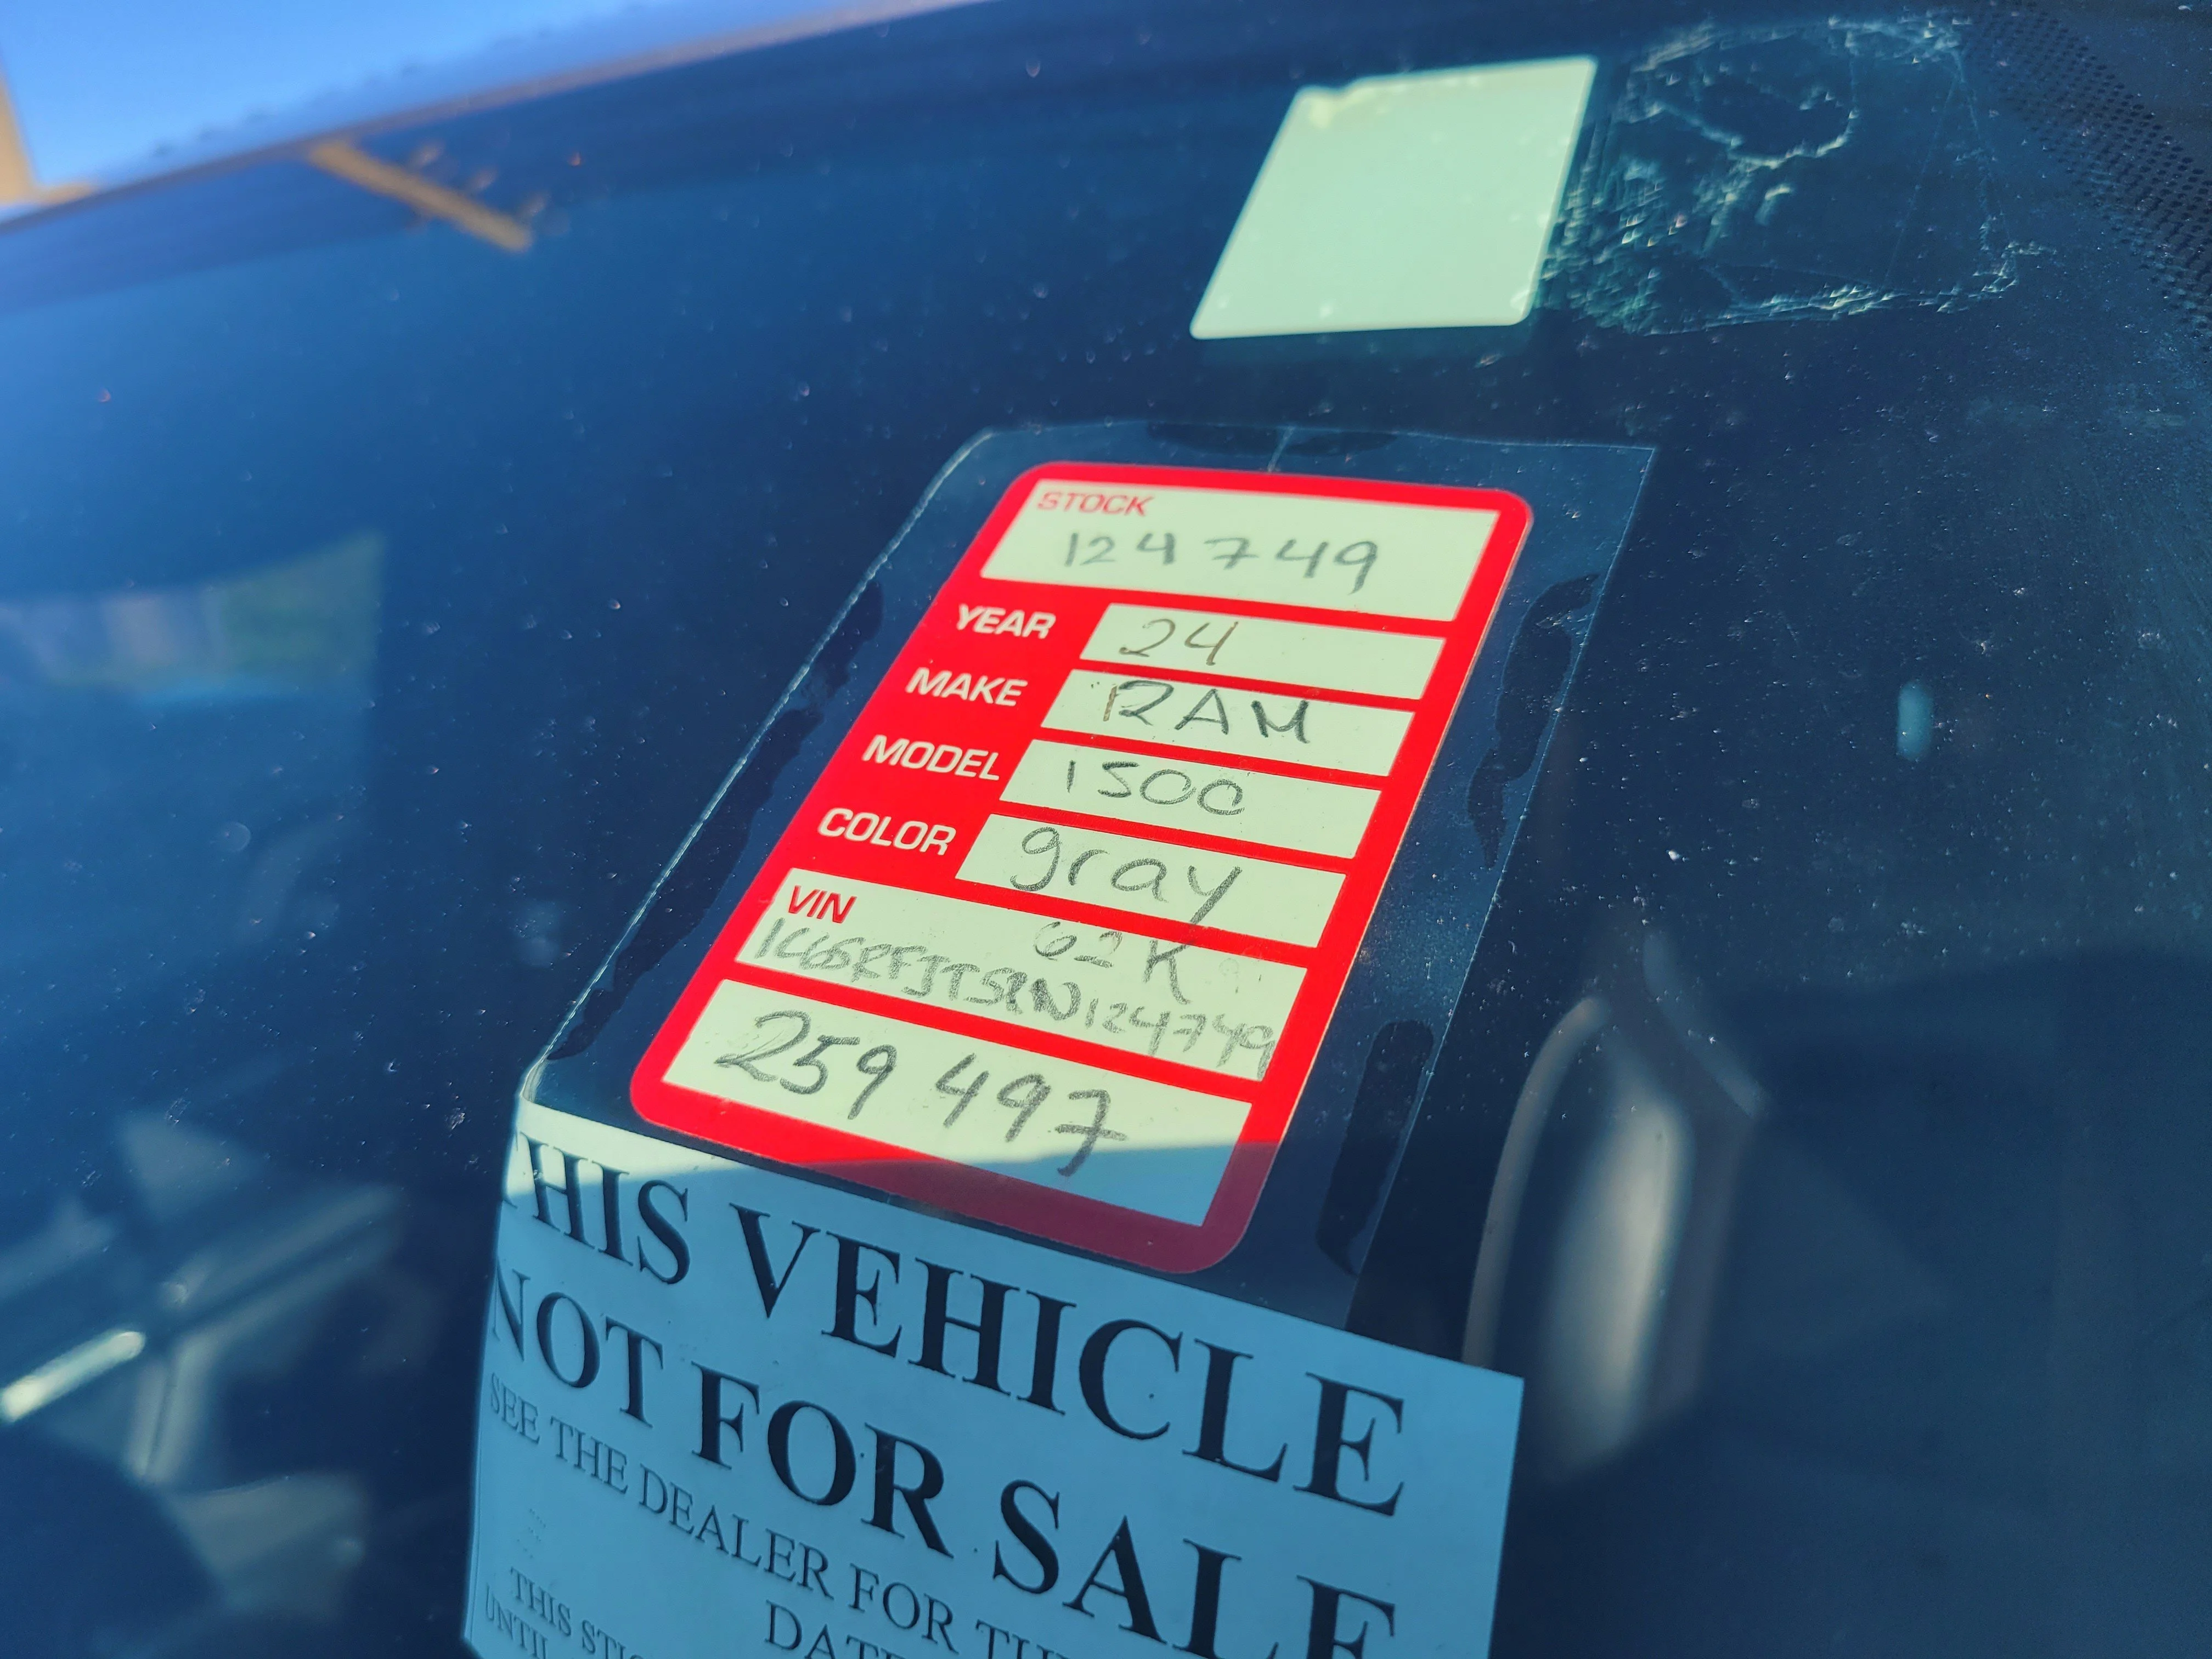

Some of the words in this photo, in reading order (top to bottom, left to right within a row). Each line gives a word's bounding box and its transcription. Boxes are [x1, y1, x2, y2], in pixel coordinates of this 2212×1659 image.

[1036, 490, 1154, 517] STOCK
[956, 604, 1057, 640] YEAR
[1118, 618, 1239, 666] 24
[905, 667, 1029, 708] MAKE
[1102, 678, 1310, 745] RAM
[863, 735, 1001, 782] MODEL
[1065, 759, 1245, 816] 1500
[818, 807, 957, 857] COLOR
[1010, 826, 1242, 924] gray
[786, 884, 857, 924] VIN
[504, 1131, 691, 1285] HIS
[729, 1202, 1404, 1517] VEHICLE
[493, 1256, 664, 1427] NOT
[691, 1361, 955, 1559] FOR
[489, 1372, 541, 1445] SEE
[550, 1414, 629, 1494] THE
[637, 1463, 835, 1601] DEALER
[847, 1562, 960, 1655] FOR
[510, 1566, 572, 1637] THIS
